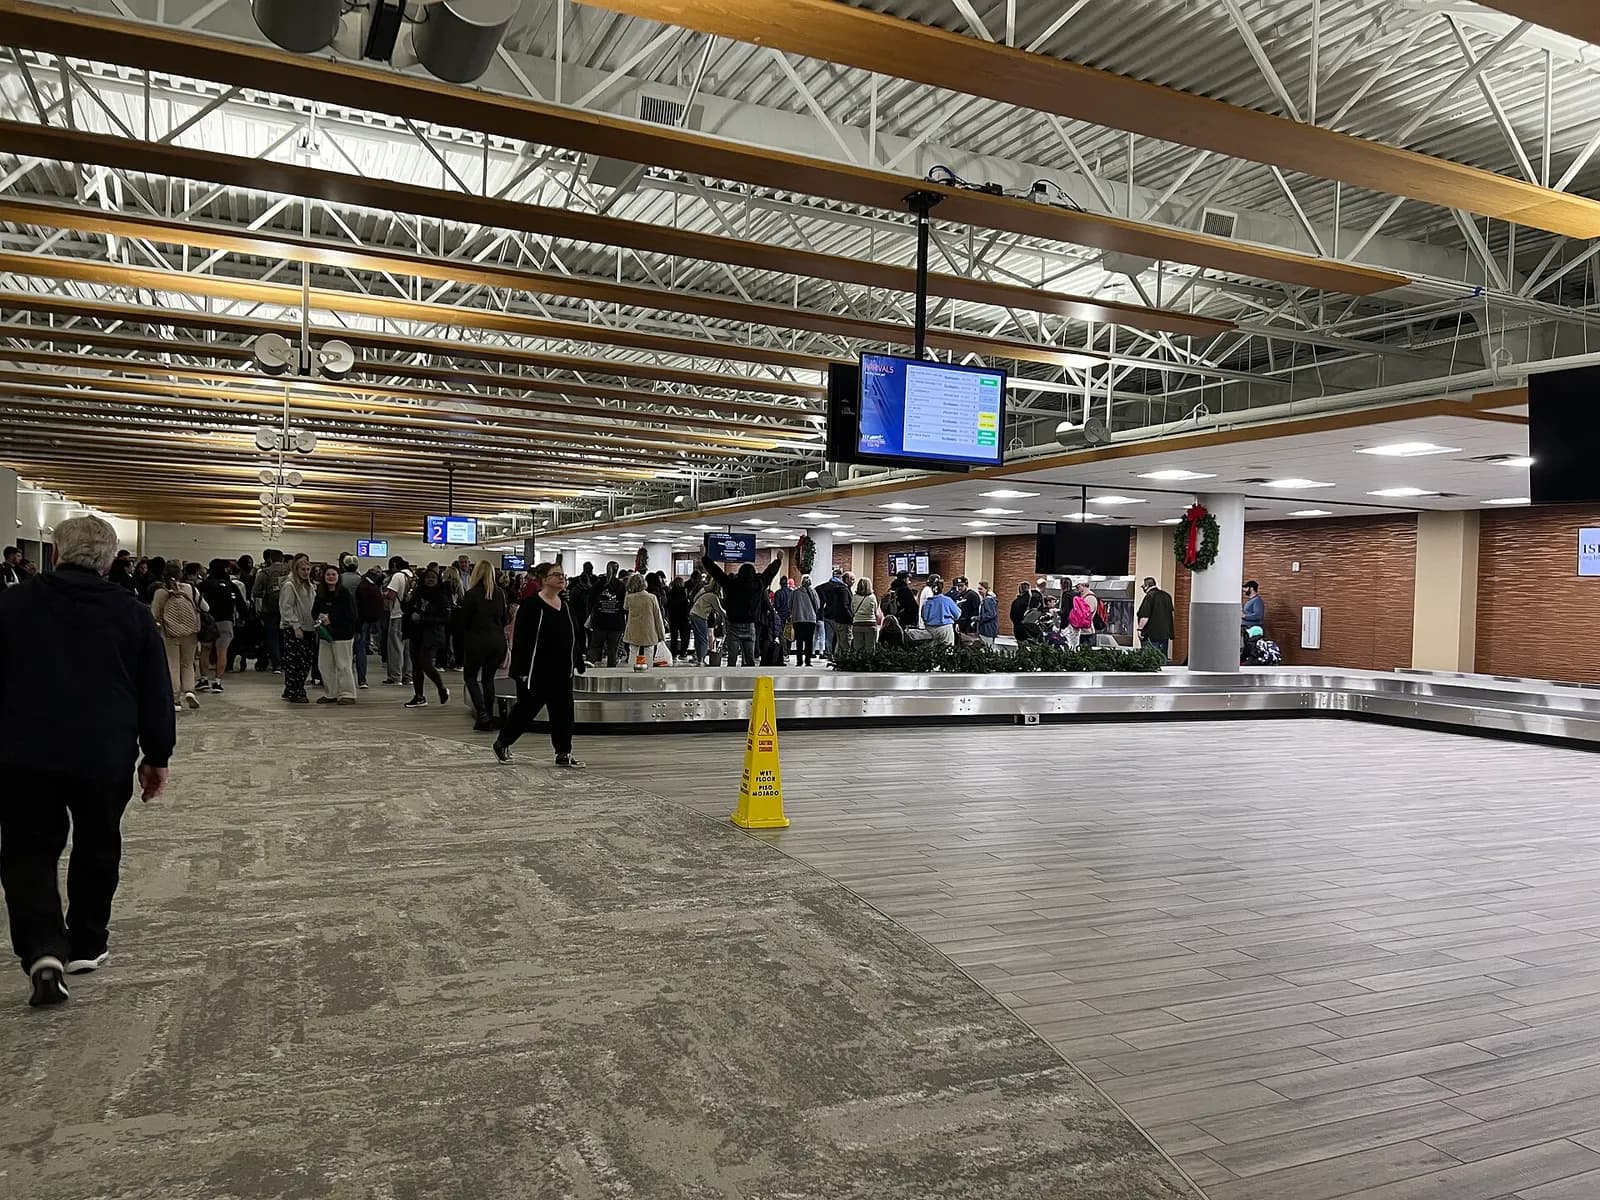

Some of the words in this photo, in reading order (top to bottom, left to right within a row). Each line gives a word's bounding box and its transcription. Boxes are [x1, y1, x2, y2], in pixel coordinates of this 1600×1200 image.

[433, 526, 442, 540] 2
[361, 546, 367, 555] 3
[911, 561, 915, 573] 2
